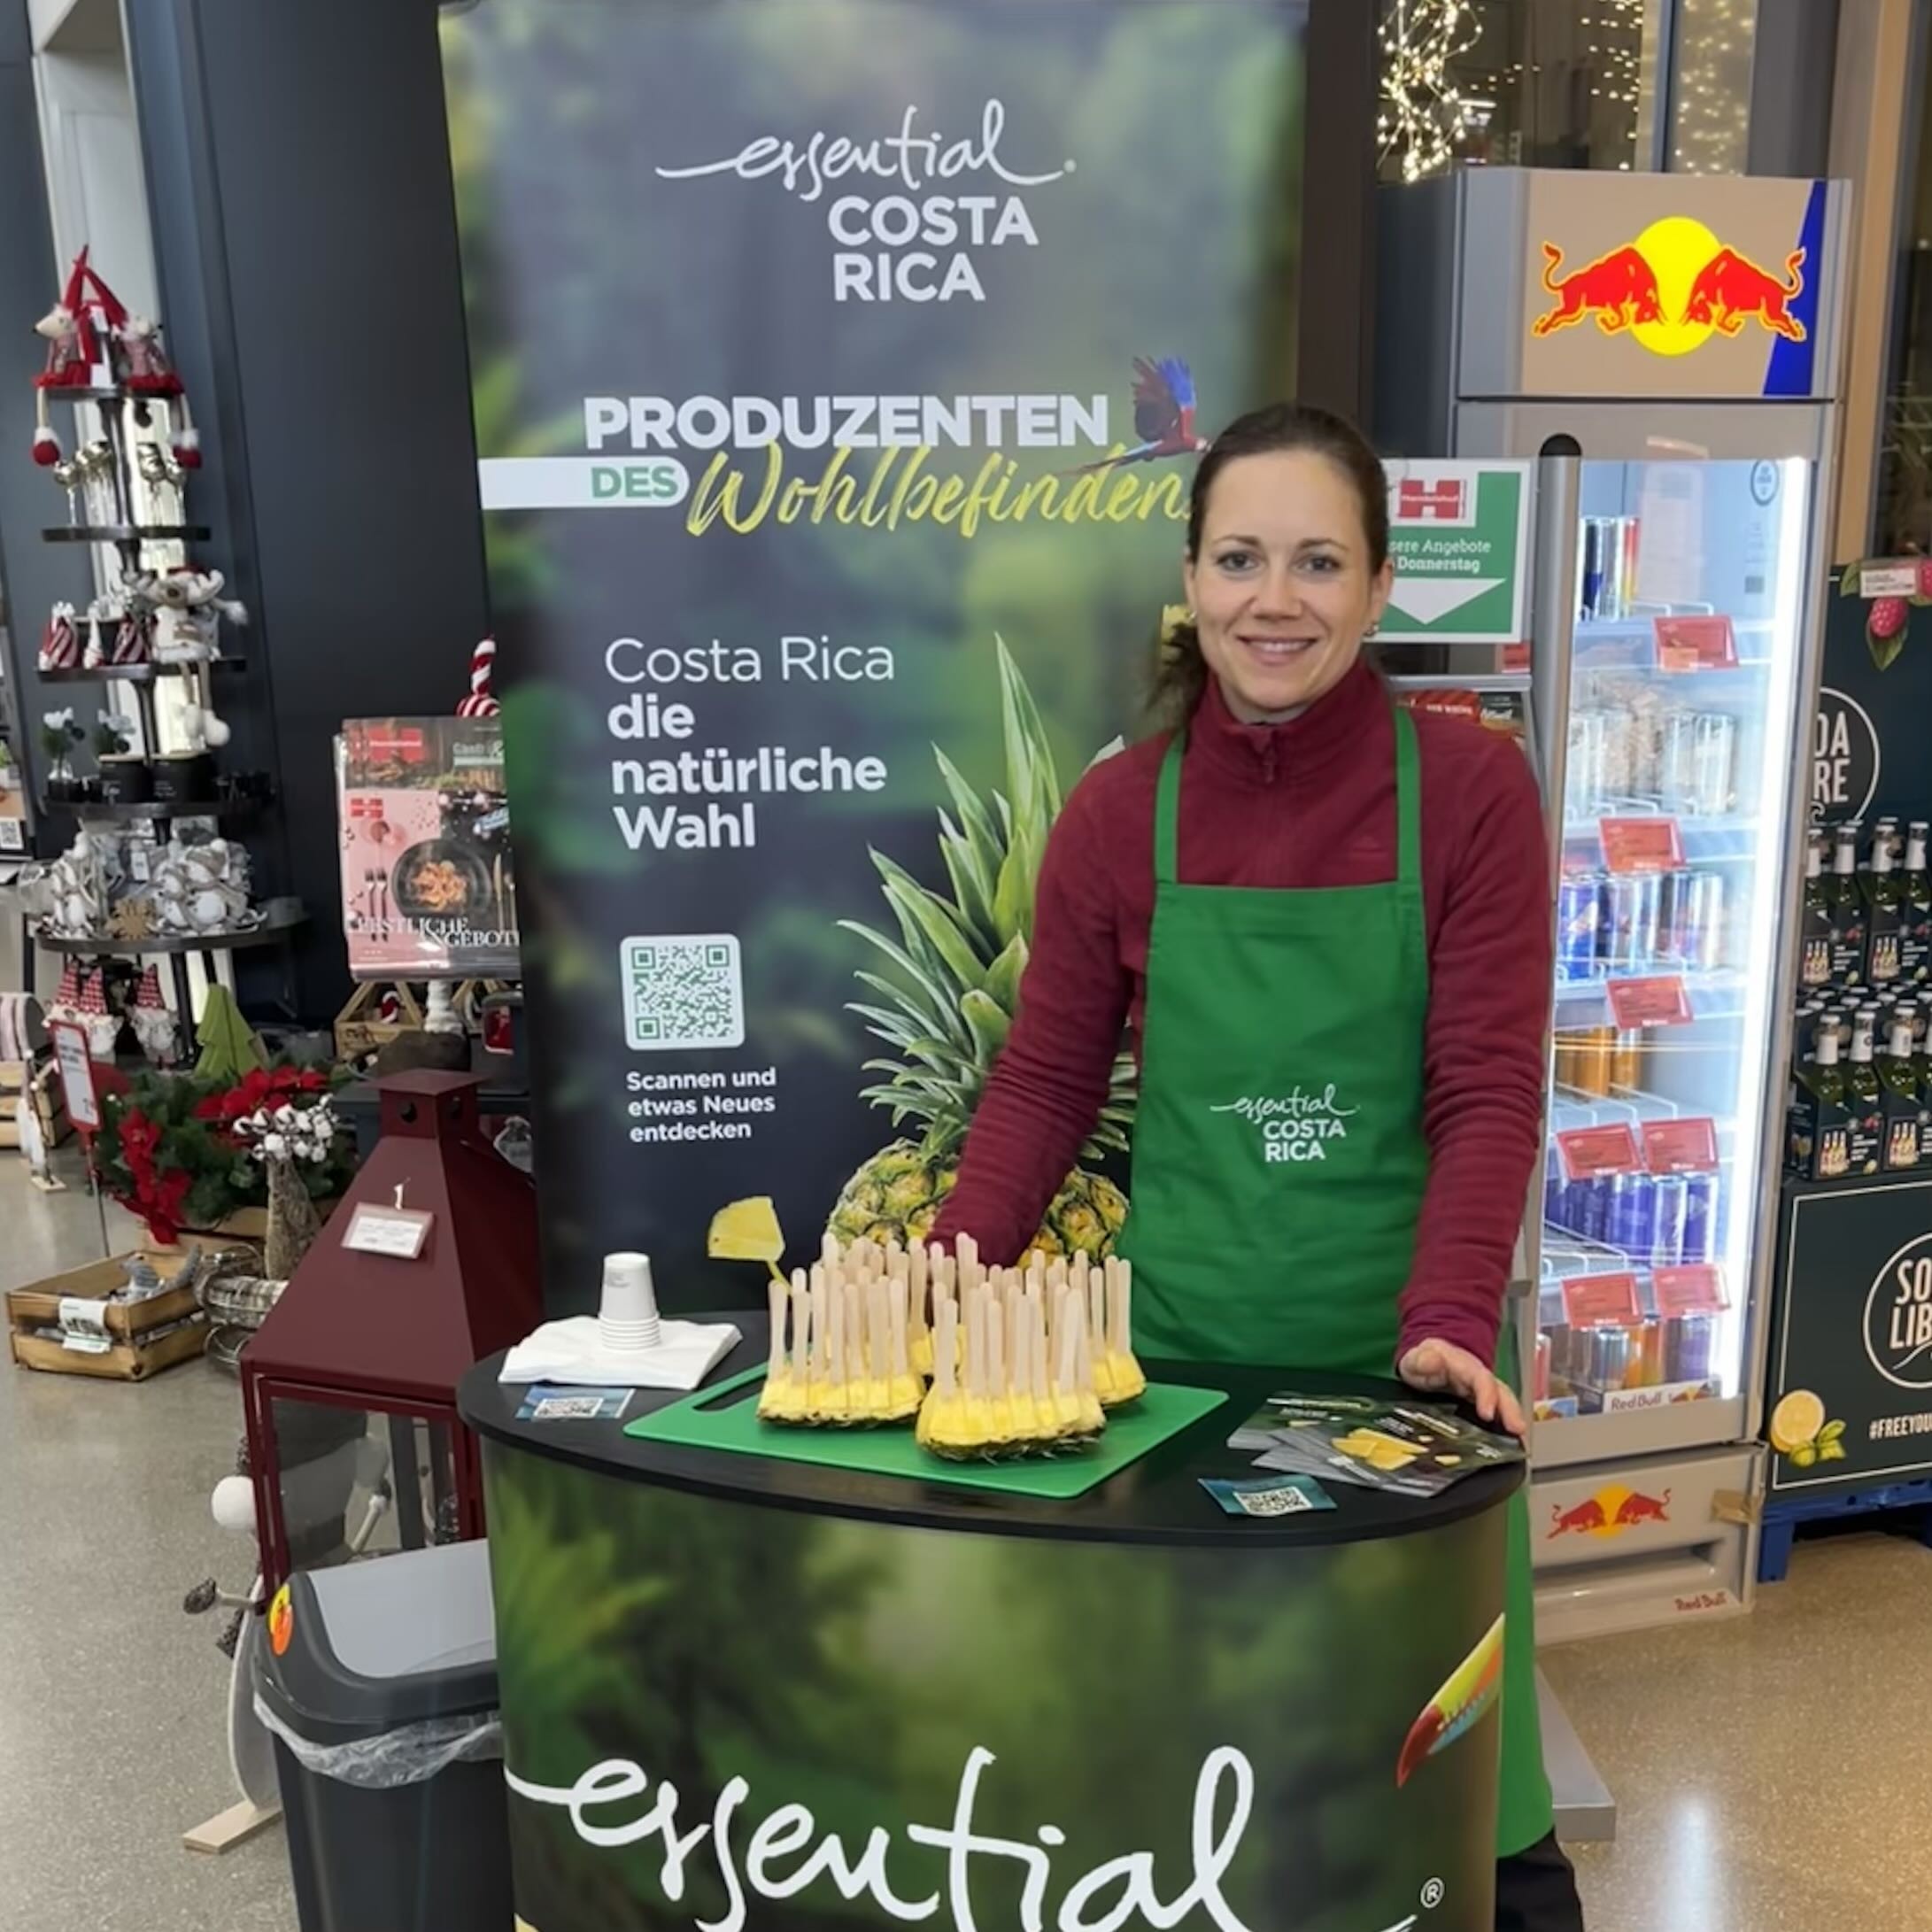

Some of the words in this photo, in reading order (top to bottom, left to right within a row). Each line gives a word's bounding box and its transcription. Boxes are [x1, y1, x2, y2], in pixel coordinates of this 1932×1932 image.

[655, 98, 1066, 200] essential
[828, 197, 1039, 245] COSTA
[834, 253, 985, 301] RICA
[583, 396, 1109, 449] PRODUZENTEN
[591, 467, 678, 498] DES
[686, 442, 1192, 537] Wohlbefinden
[1388, 539, 1420, 553] sere
[1422, 538, 1491, 557] Angebote
[1397, 556, 1481, 574] Donnerstag
[606, 638, 761, 683] Costa
[779, 636, 895, 681] Rica
[607, 693, 696, 738] die
[612, 747, 887, 795] natürliche
[614, 803, 756, 850] Wahl
[626, 1071, 725, 1090] Scannen
[732, 1066, 776, 1086] und
[628, 1098, 697, 1117] etwas
[703, 1095, 776, 1114] Neues
[1209, 1083, 1357, 1124] essential
[630, 1120, 752, 1143] entdecken
[1263, 1118, 1347, 1140] COSTA
[1264, 1140, 1325, 1162] RICA
